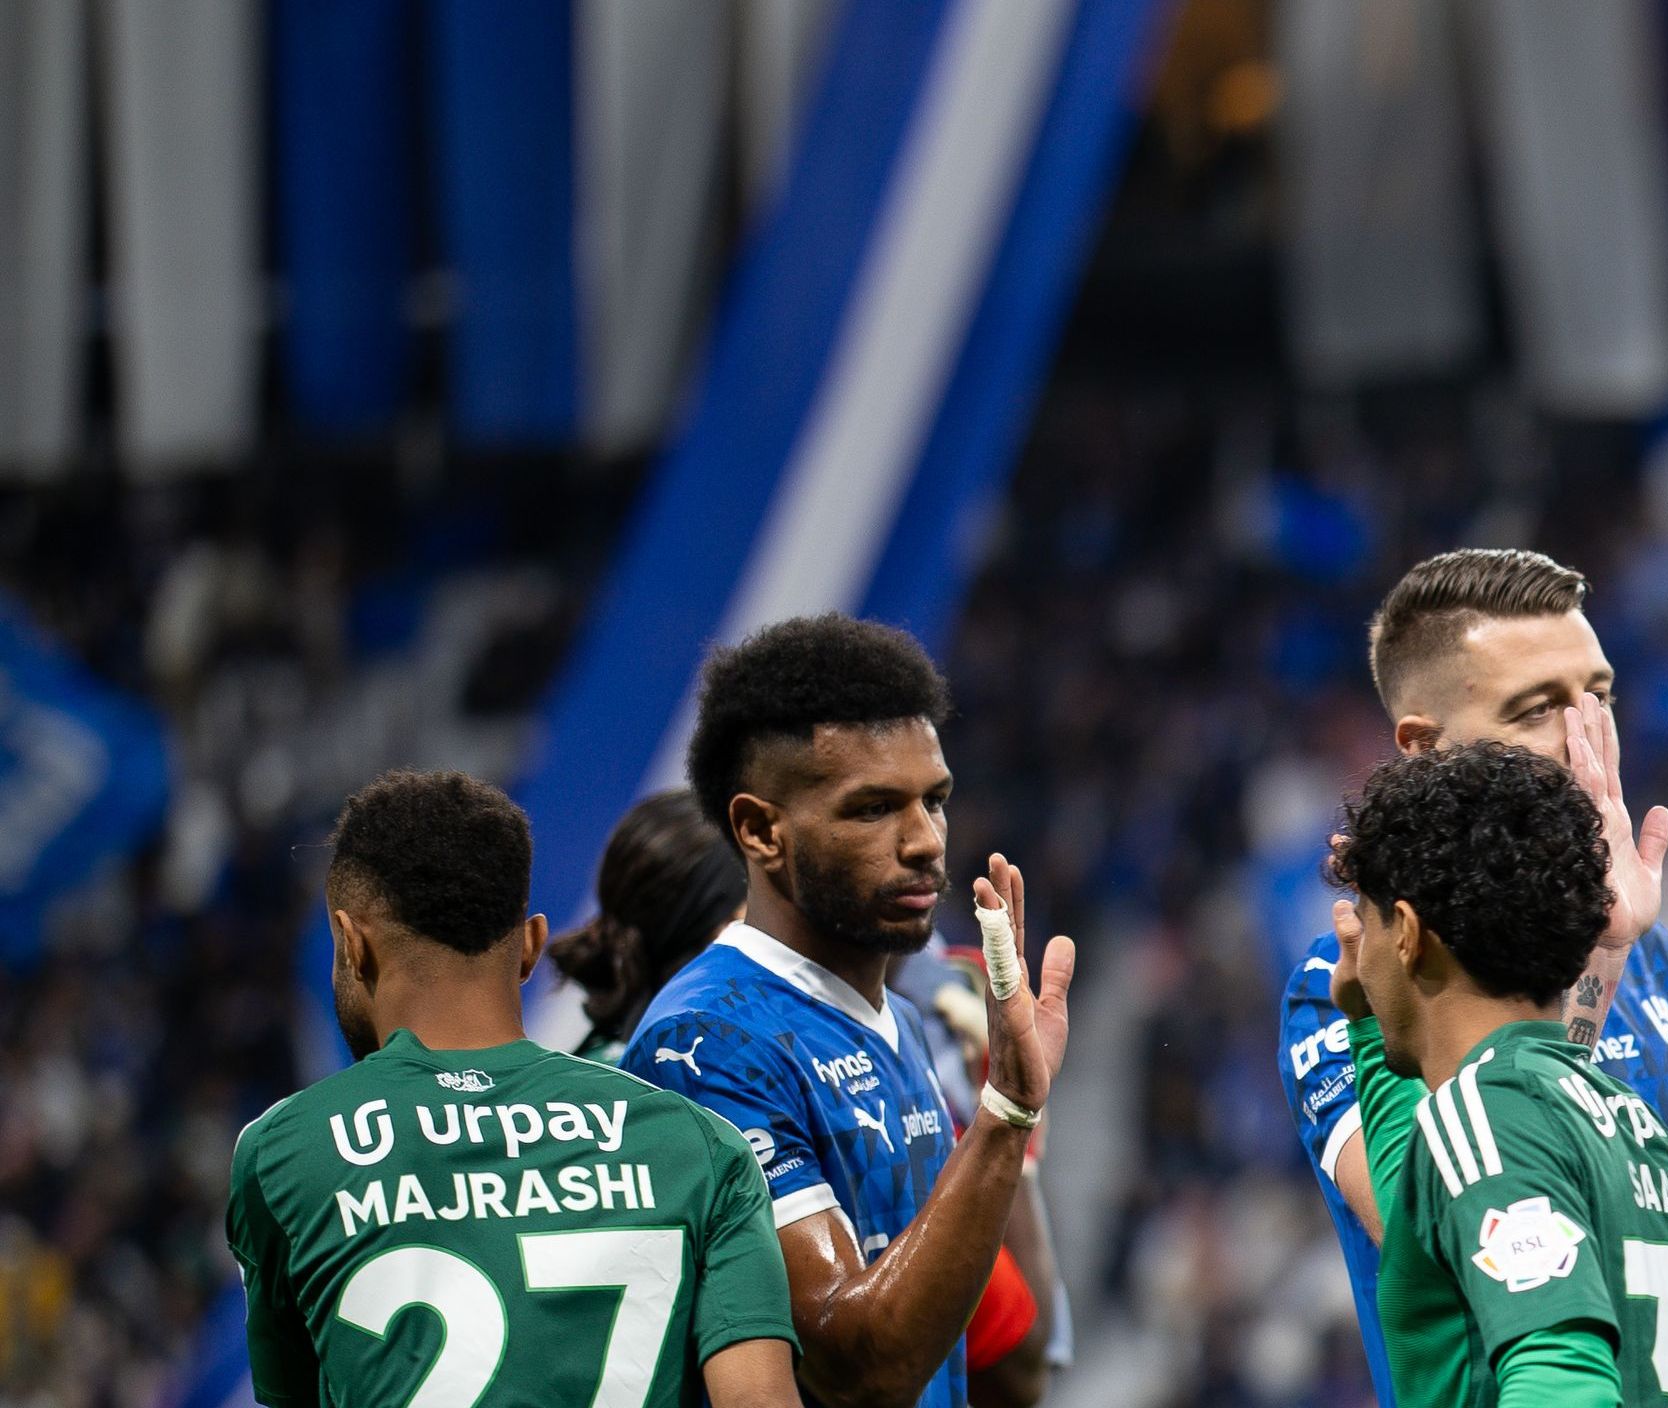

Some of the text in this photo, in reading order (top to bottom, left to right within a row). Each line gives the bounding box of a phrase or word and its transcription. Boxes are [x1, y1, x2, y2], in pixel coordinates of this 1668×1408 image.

[1290, 1019, 1352, 1080] tre
[416, 1100, 628, 1158] urpay
[335, 1163, 656, 1237] MAJRASHI
[1511, 1235, 1548, 1255] RSL
